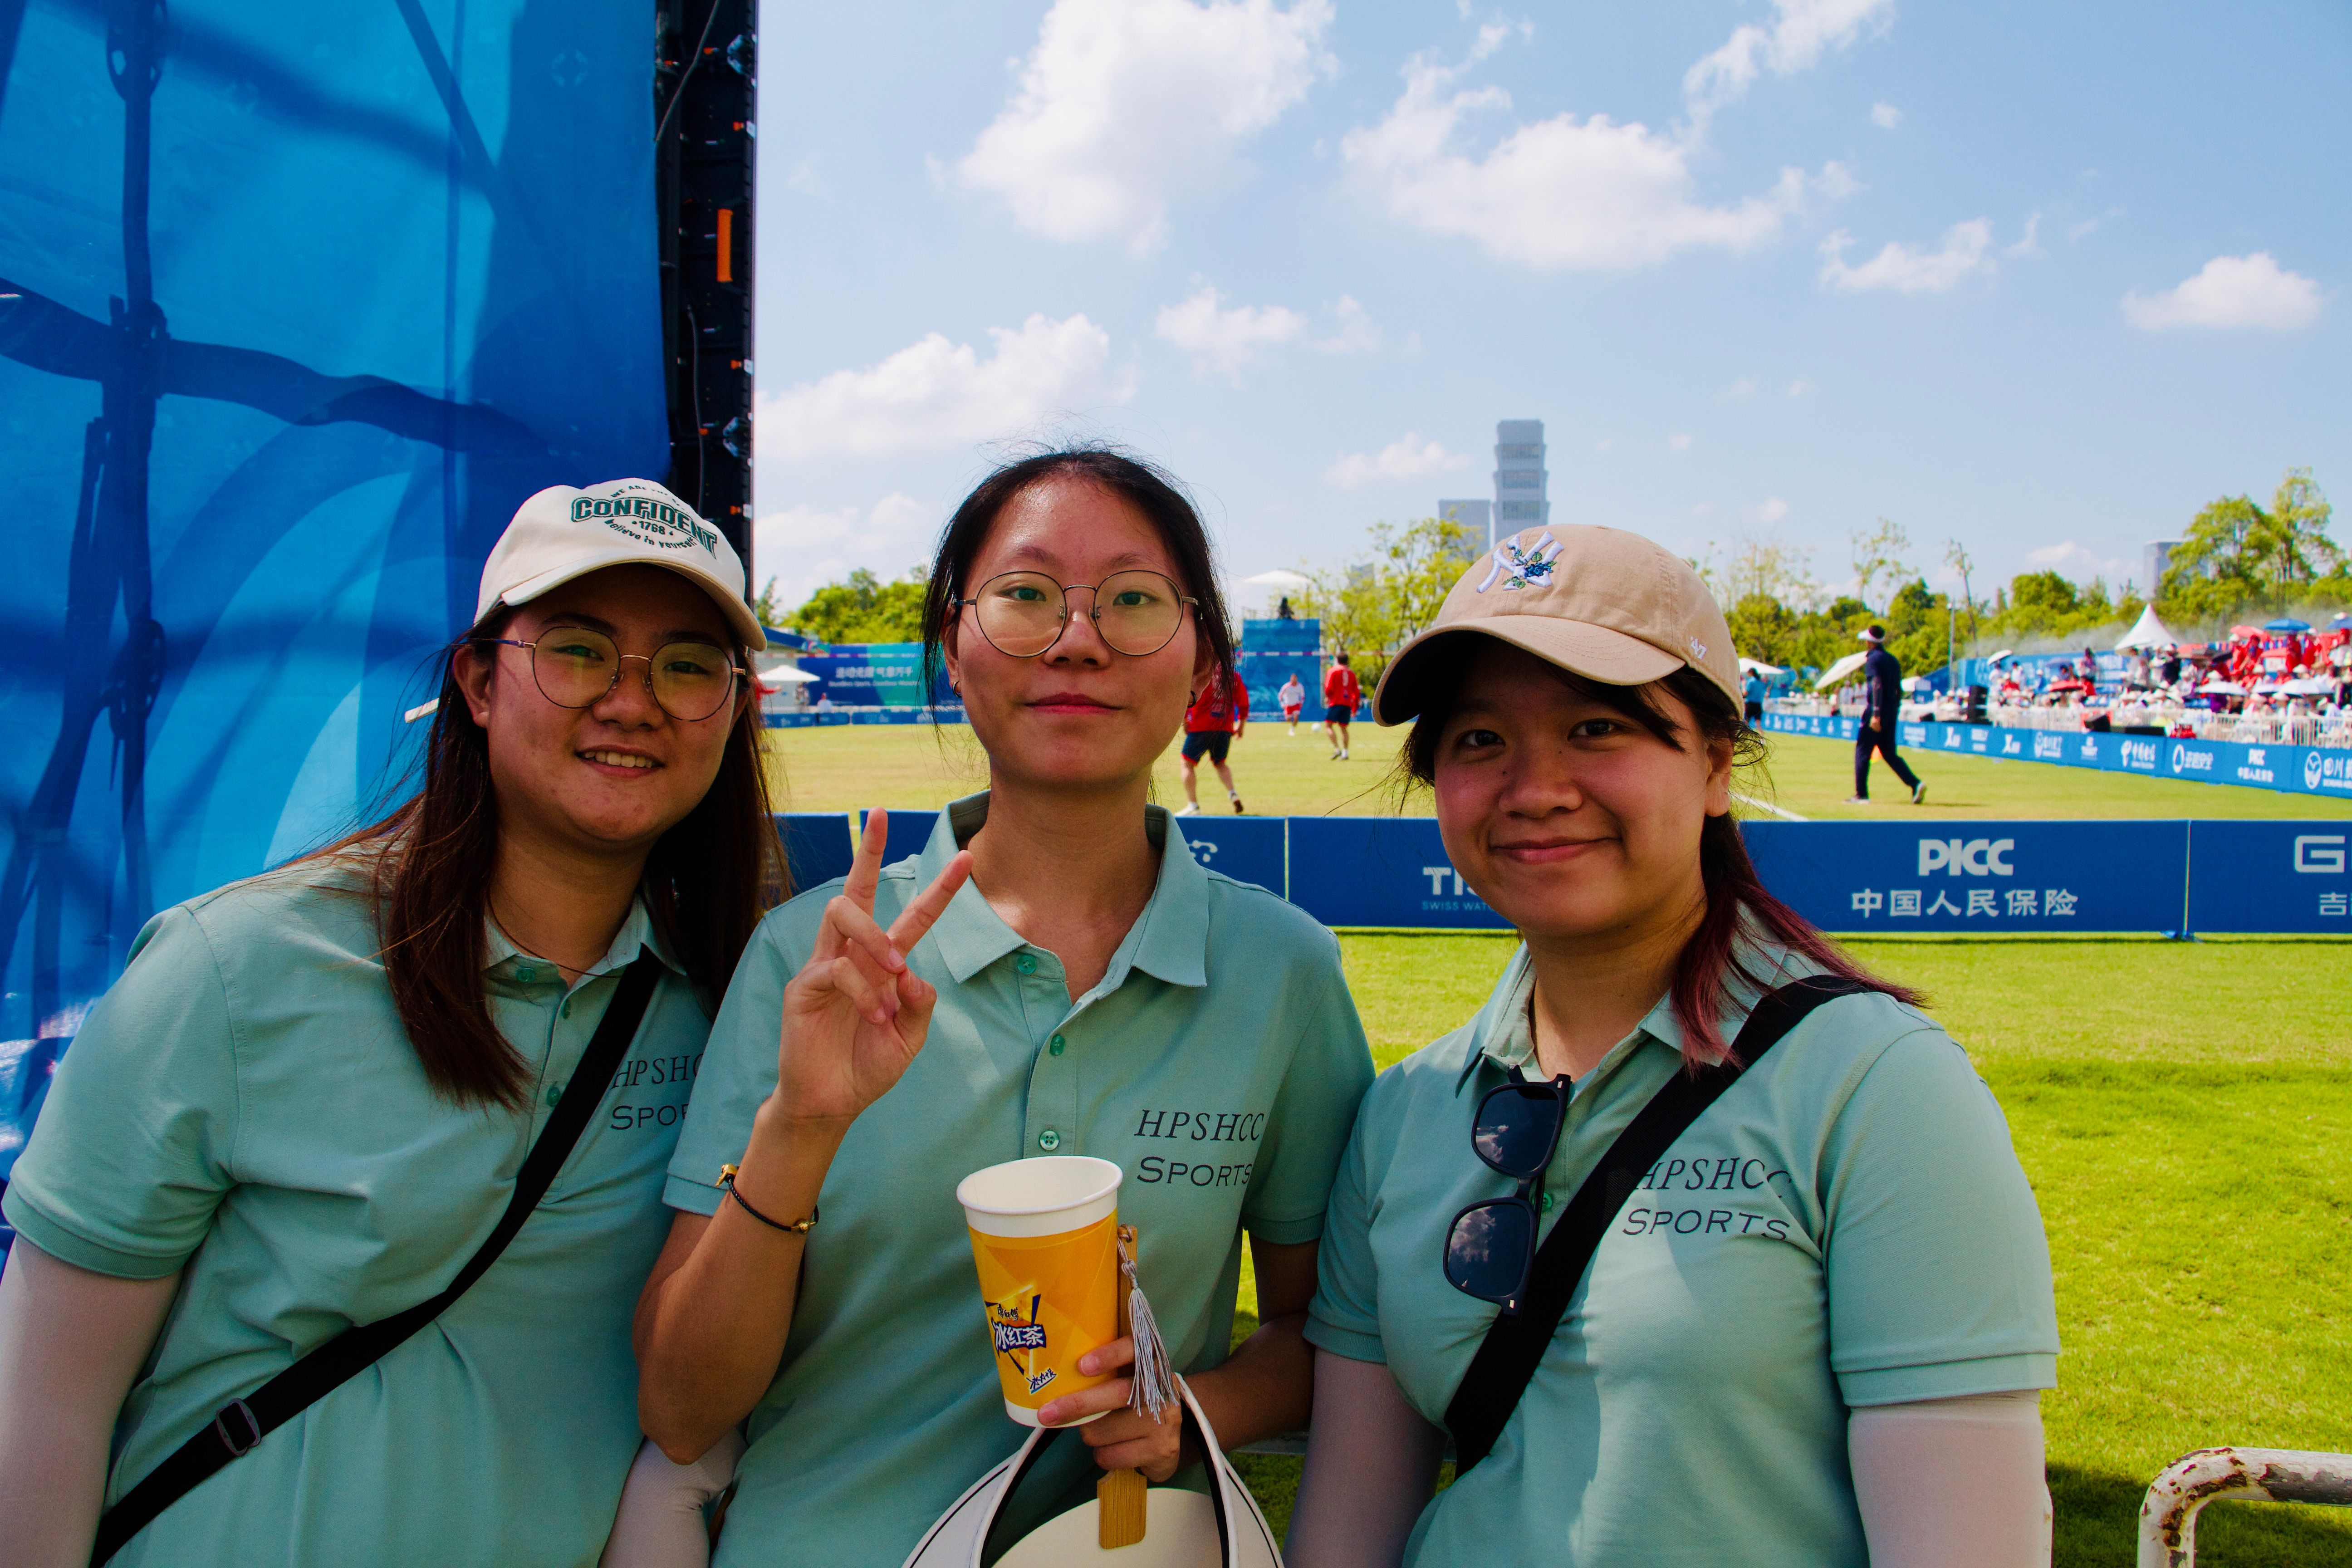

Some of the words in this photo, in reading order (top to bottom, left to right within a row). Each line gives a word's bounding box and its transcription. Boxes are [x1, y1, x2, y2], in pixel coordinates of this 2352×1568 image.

[572, 497, 717, 559] CONFIDENT
[639, 521, 666, 535] 1768
[644, 535, 655, 545] in
[1918, 838, 2014, 876] PICC
[1851, 888, 2079, 918] 中国人民保险
[1134, 1109, 1264, 1142] HPSHCC
[1137, 1156, 1252, 1186] SPORTS
[1622, 1208, 1790, 1240] SPORTS
[992, 1320, 1043, 1350] 冰红茶
